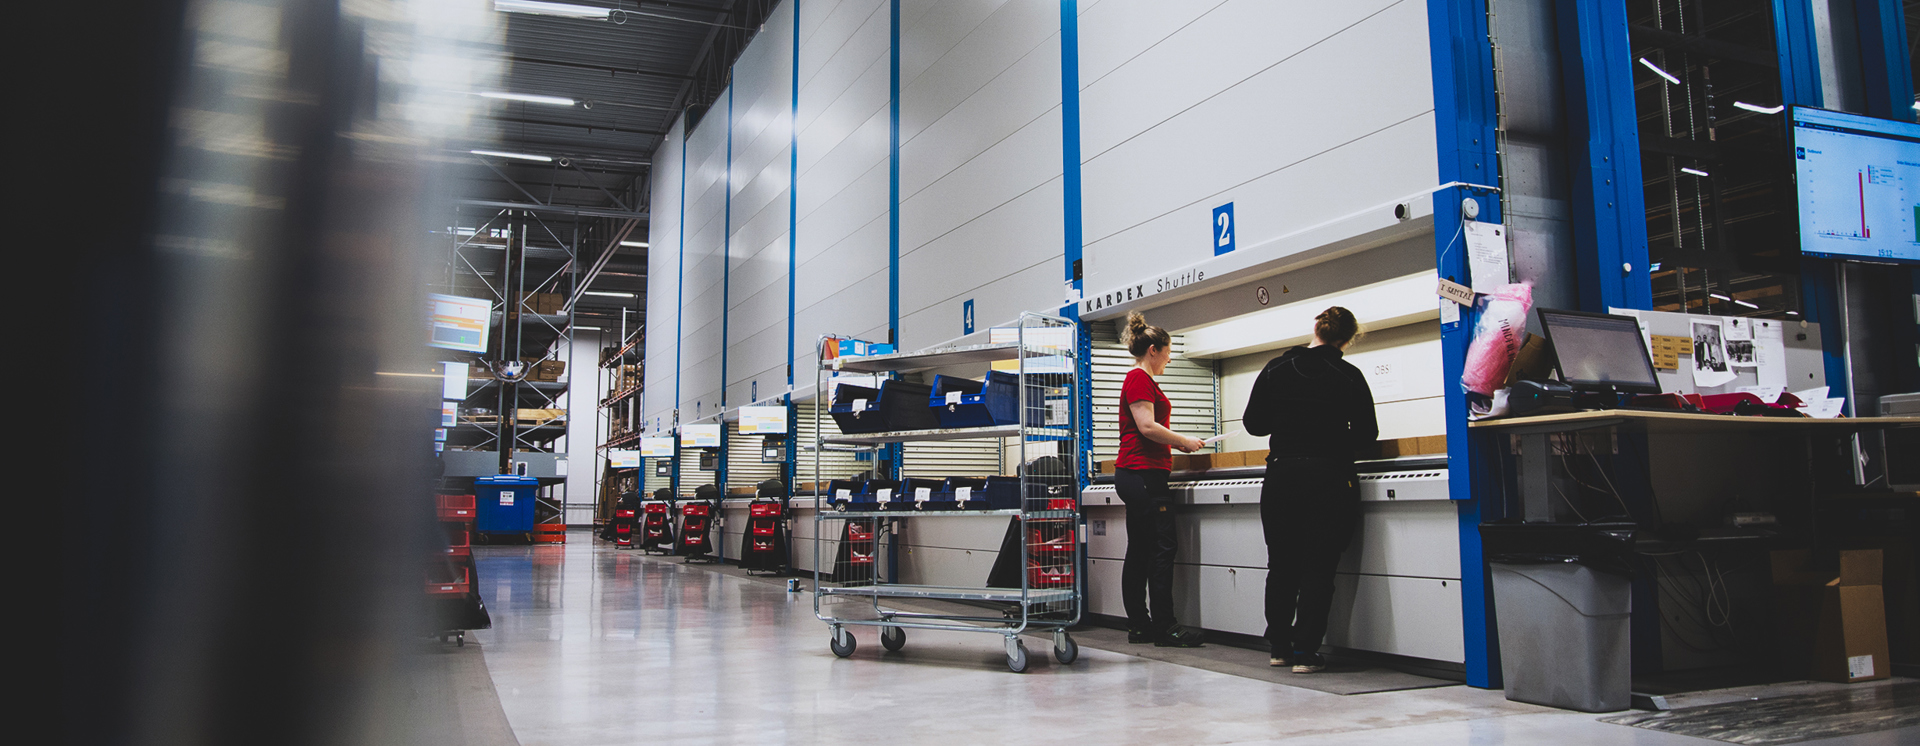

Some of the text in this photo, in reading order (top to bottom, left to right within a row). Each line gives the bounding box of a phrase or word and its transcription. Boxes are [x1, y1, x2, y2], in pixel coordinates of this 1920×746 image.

[1217, 212, 1230, 247] 2
[1086, 268, 1205, 313] KARDEX Shuttle
[966, 304, 972, 328] 4
